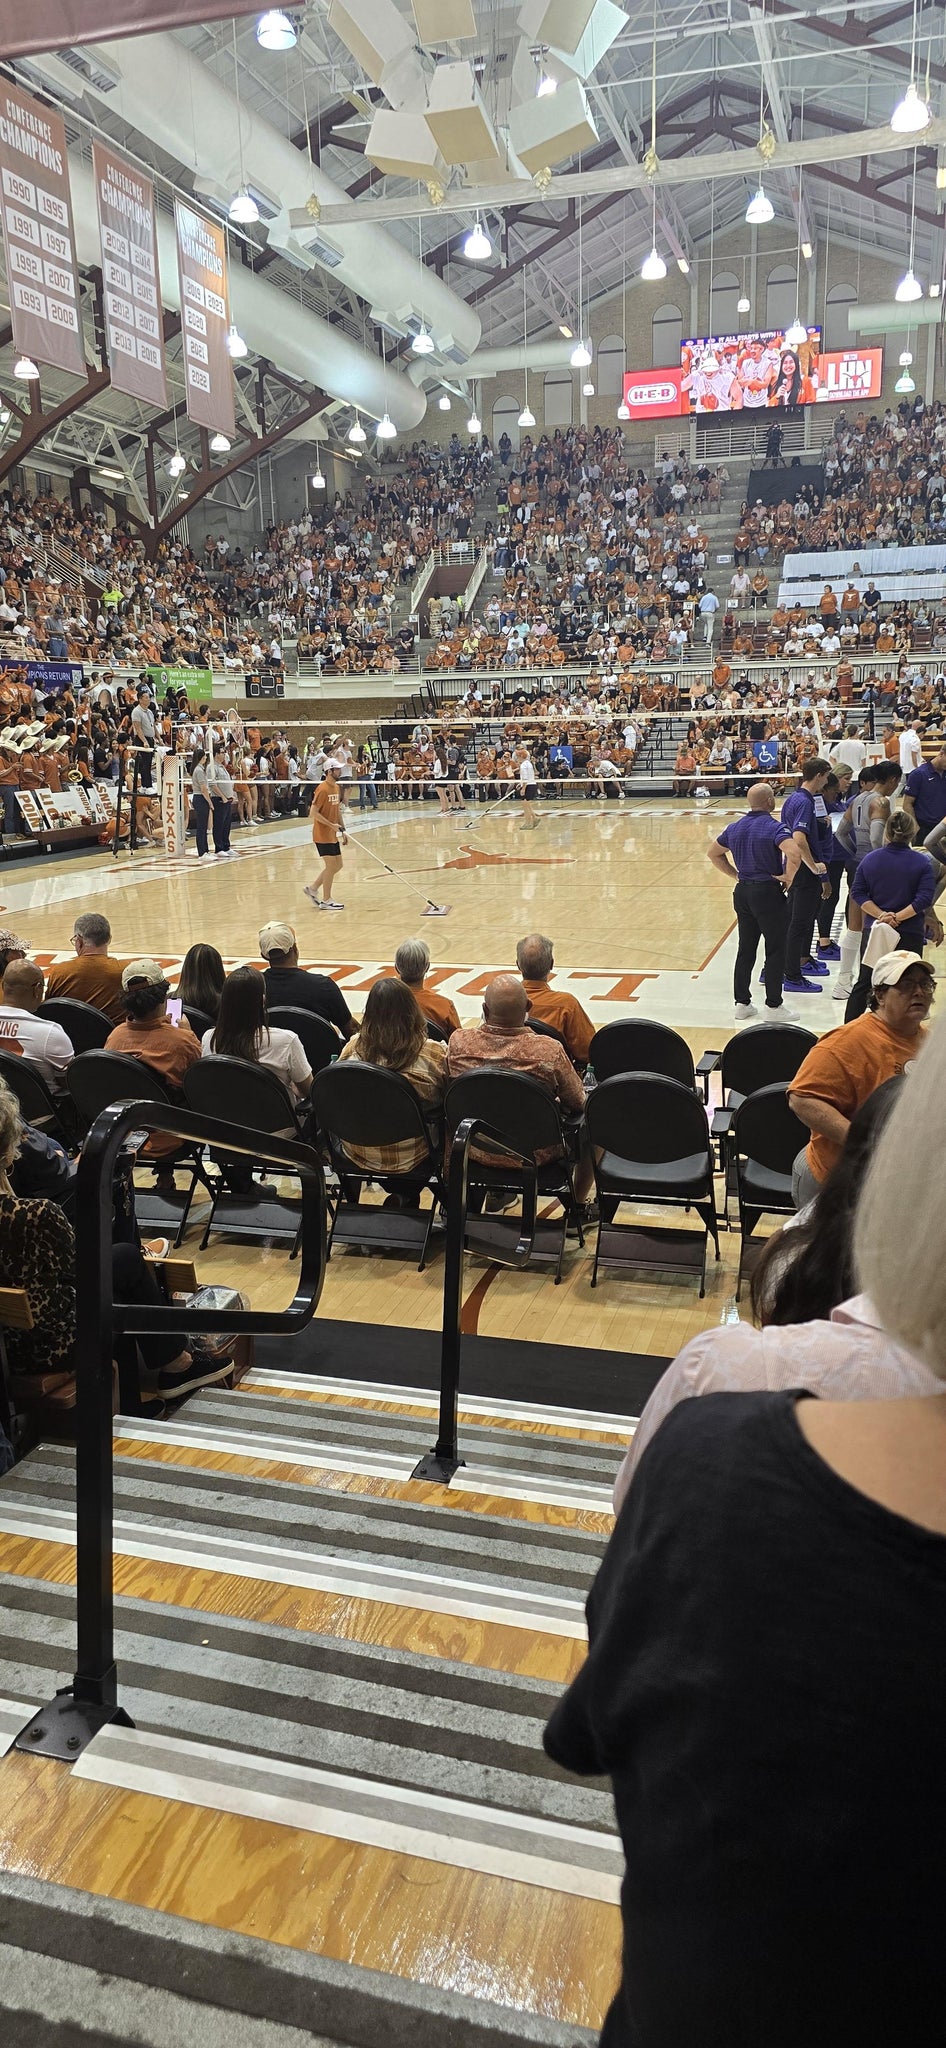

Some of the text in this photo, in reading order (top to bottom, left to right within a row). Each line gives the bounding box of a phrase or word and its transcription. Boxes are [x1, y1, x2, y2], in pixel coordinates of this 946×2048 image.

[6, 98, 53, 144] CONFERENCE
[0, 115, 63, 176] CHAMPIONS
[8, 176, 64, 221] 1990 1995
[100, 178, 152, 232] CHAMPIONS
[13, 215, 67, 256] 1991 1997
[181, 232, 224, 280] CHAMPIONS
[15, 251, 71, 292] 1992 2007
[19, 289, 75, 327] 1993 2008
[828, 359, 873, 391] LHN
[49, 671, 71, 680] RETURN
[165, 782, 176, 853] TEXAS
[857, 806, 862, 826] 1
